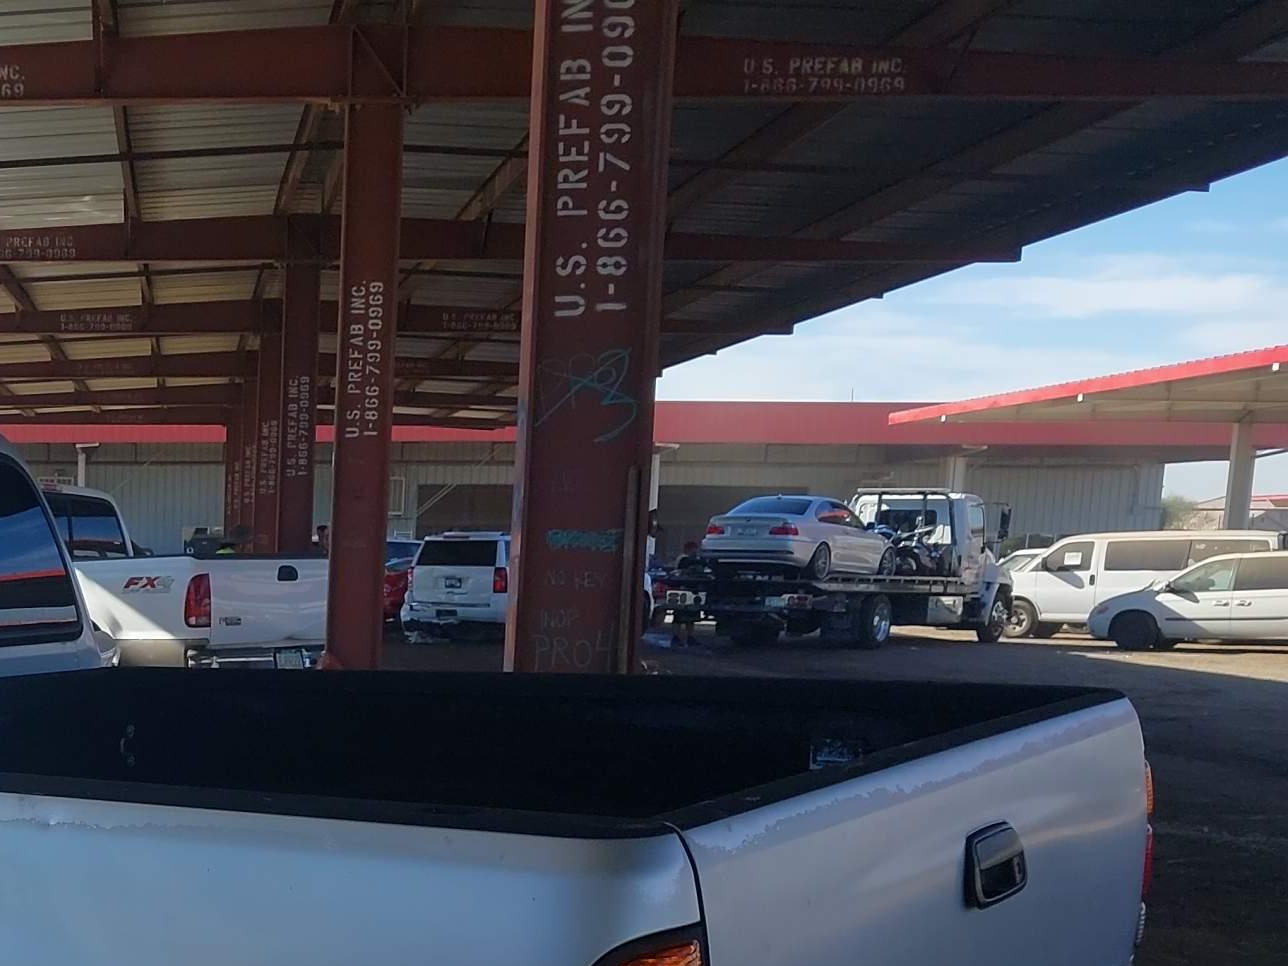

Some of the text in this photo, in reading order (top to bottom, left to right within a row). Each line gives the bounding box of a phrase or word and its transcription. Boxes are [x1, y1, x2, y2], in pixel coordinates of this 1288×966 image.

[557, 58, 591, 217] PREFAB
[789, 57, 864, 75] PREFAB
[555, 243, 588, 317] U.S.
[344, 280, 367, 438] U.S. PREFAB INC.
[363, 281, 385, 436] 1-866-799-0969
